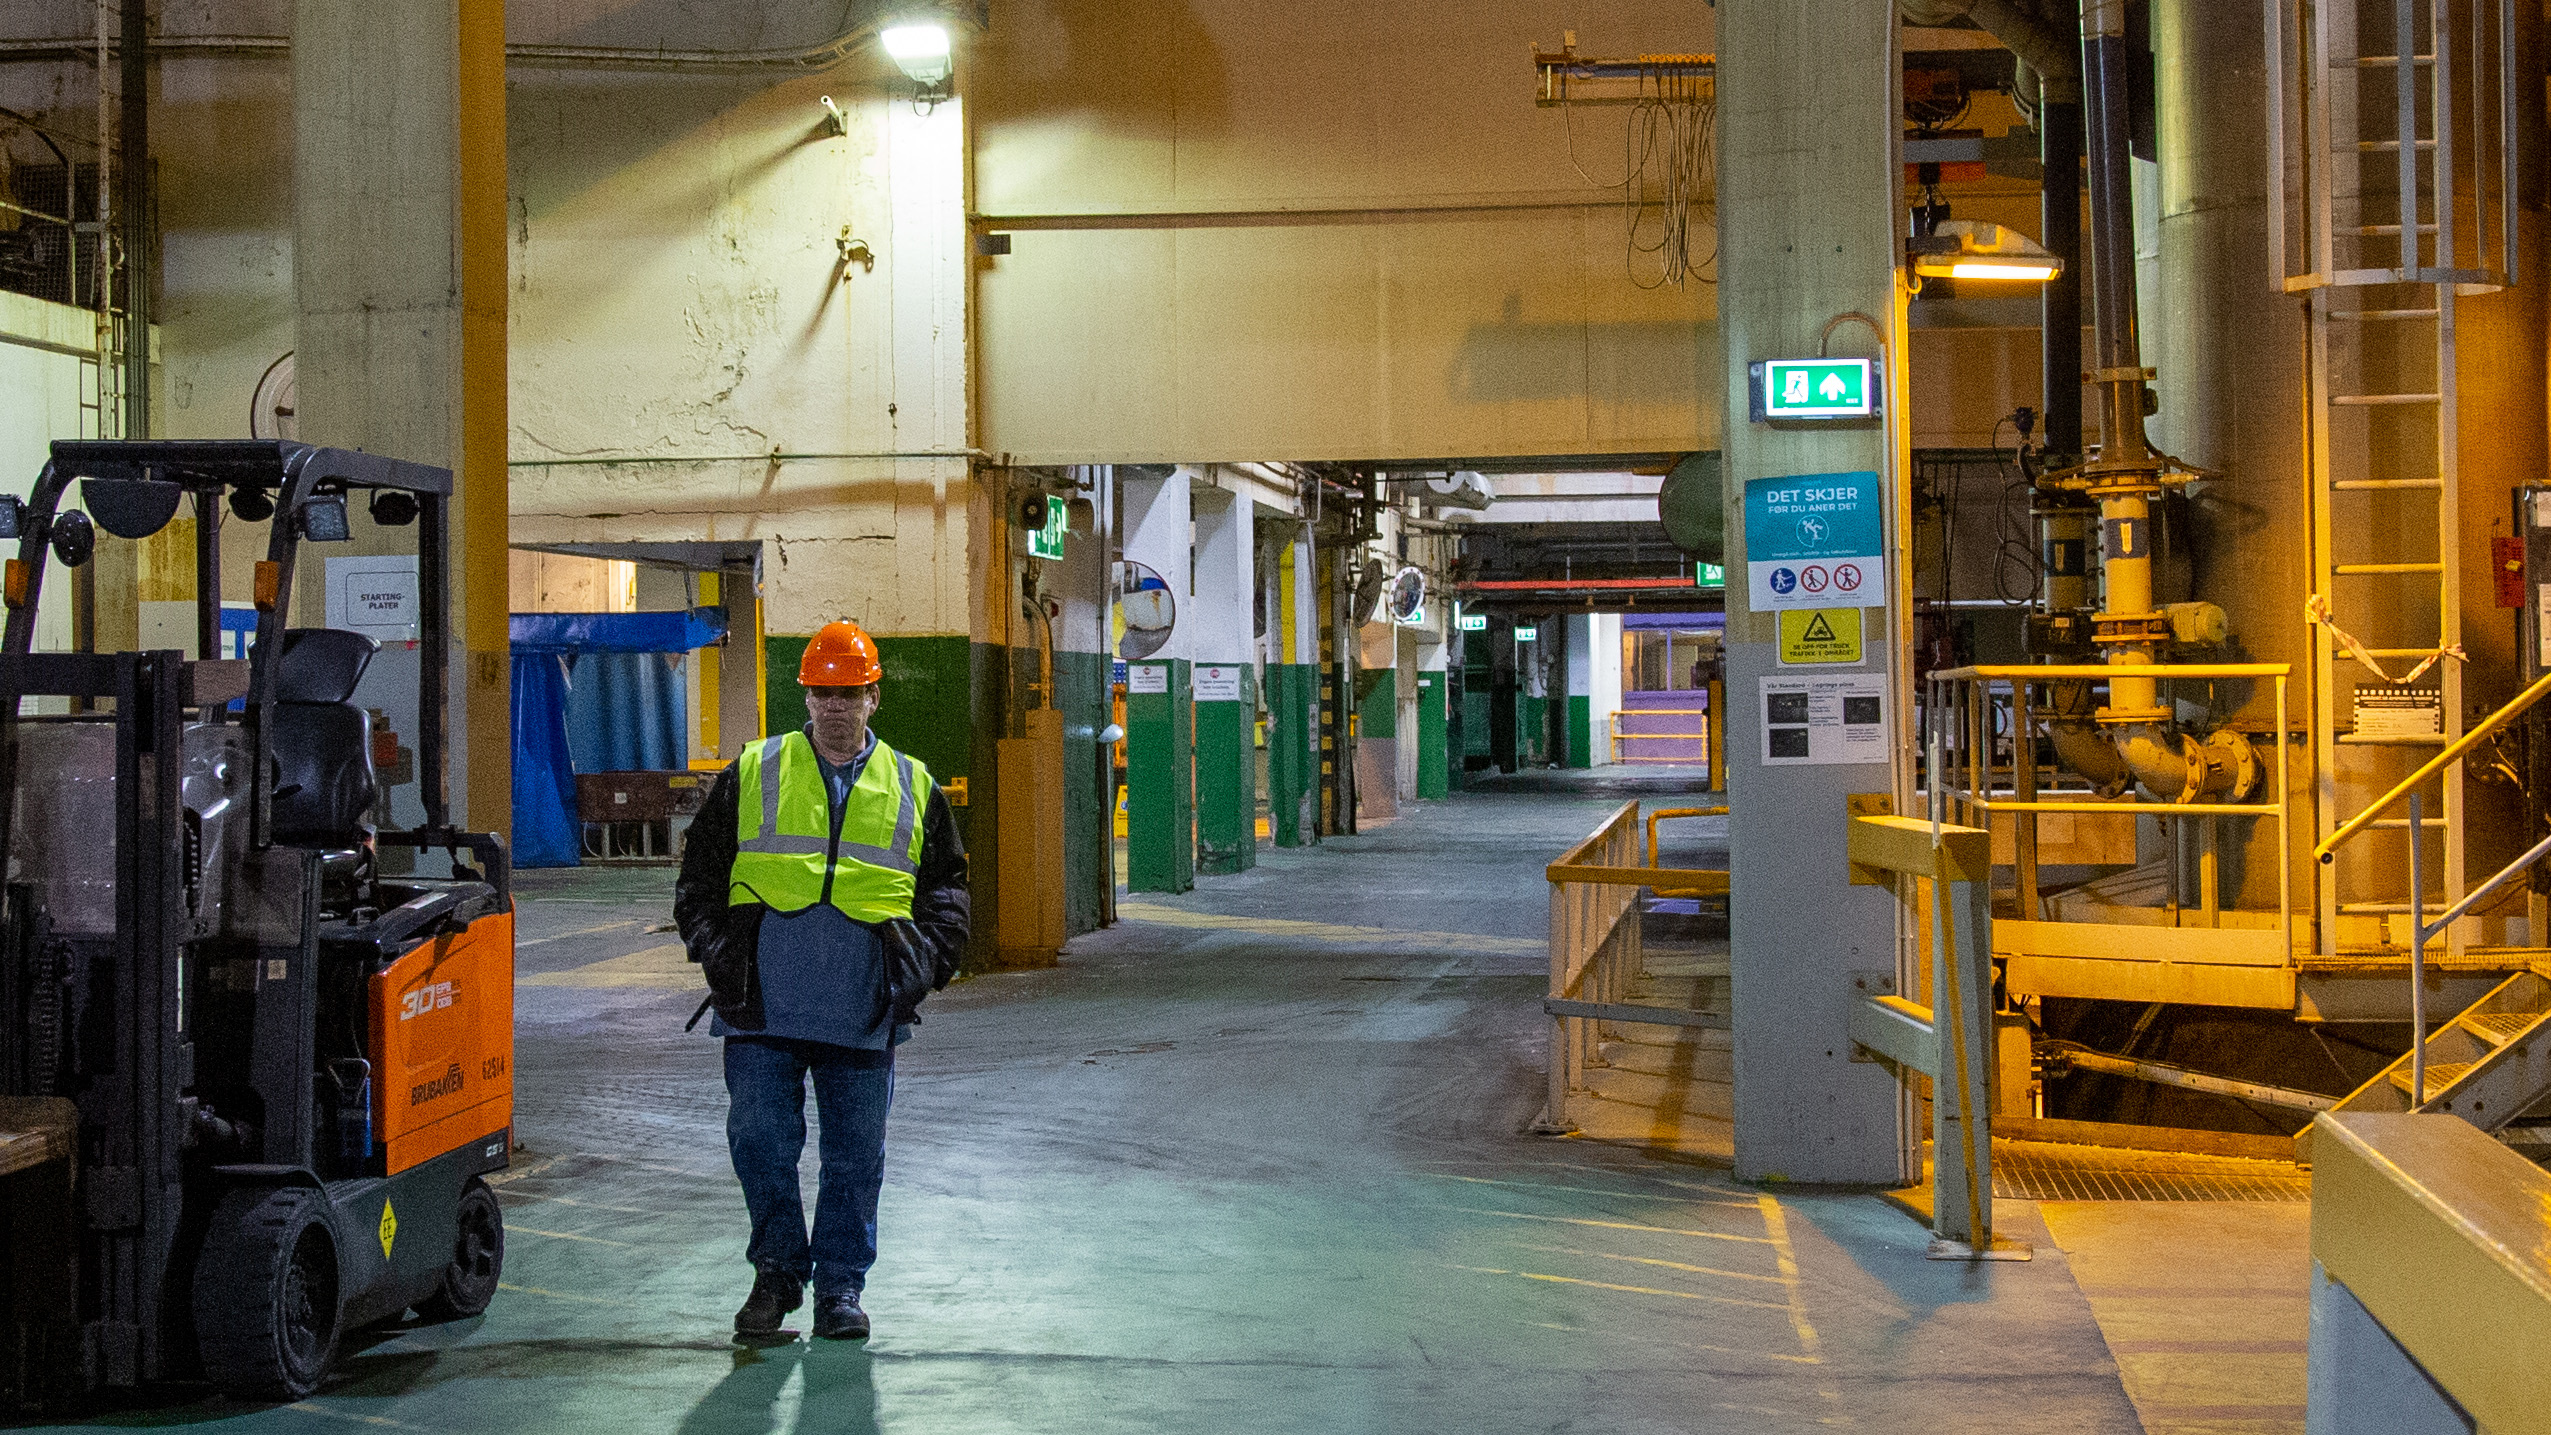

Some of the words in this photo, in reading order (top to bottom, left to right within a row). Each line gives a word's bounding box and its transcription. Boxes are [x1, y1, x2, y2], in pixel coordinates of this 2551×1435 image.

[1767, 489, 1801, 503] DET
[1805, 487, 1858, 502] SKJER
[1768, 505, 1789, 514] FØR
[1791, 504, 1806, 513] DU
[1808, 503, 1835, 512] ANER
[1838, 502, 1858, 511] DET
[361, 593, 405, 601] STARTING-
[400, 984, 436, 1022] 30
[411, 1063, 464, 1106] BRUBAKKEN
[383, 1217, 393, 1241] EE
